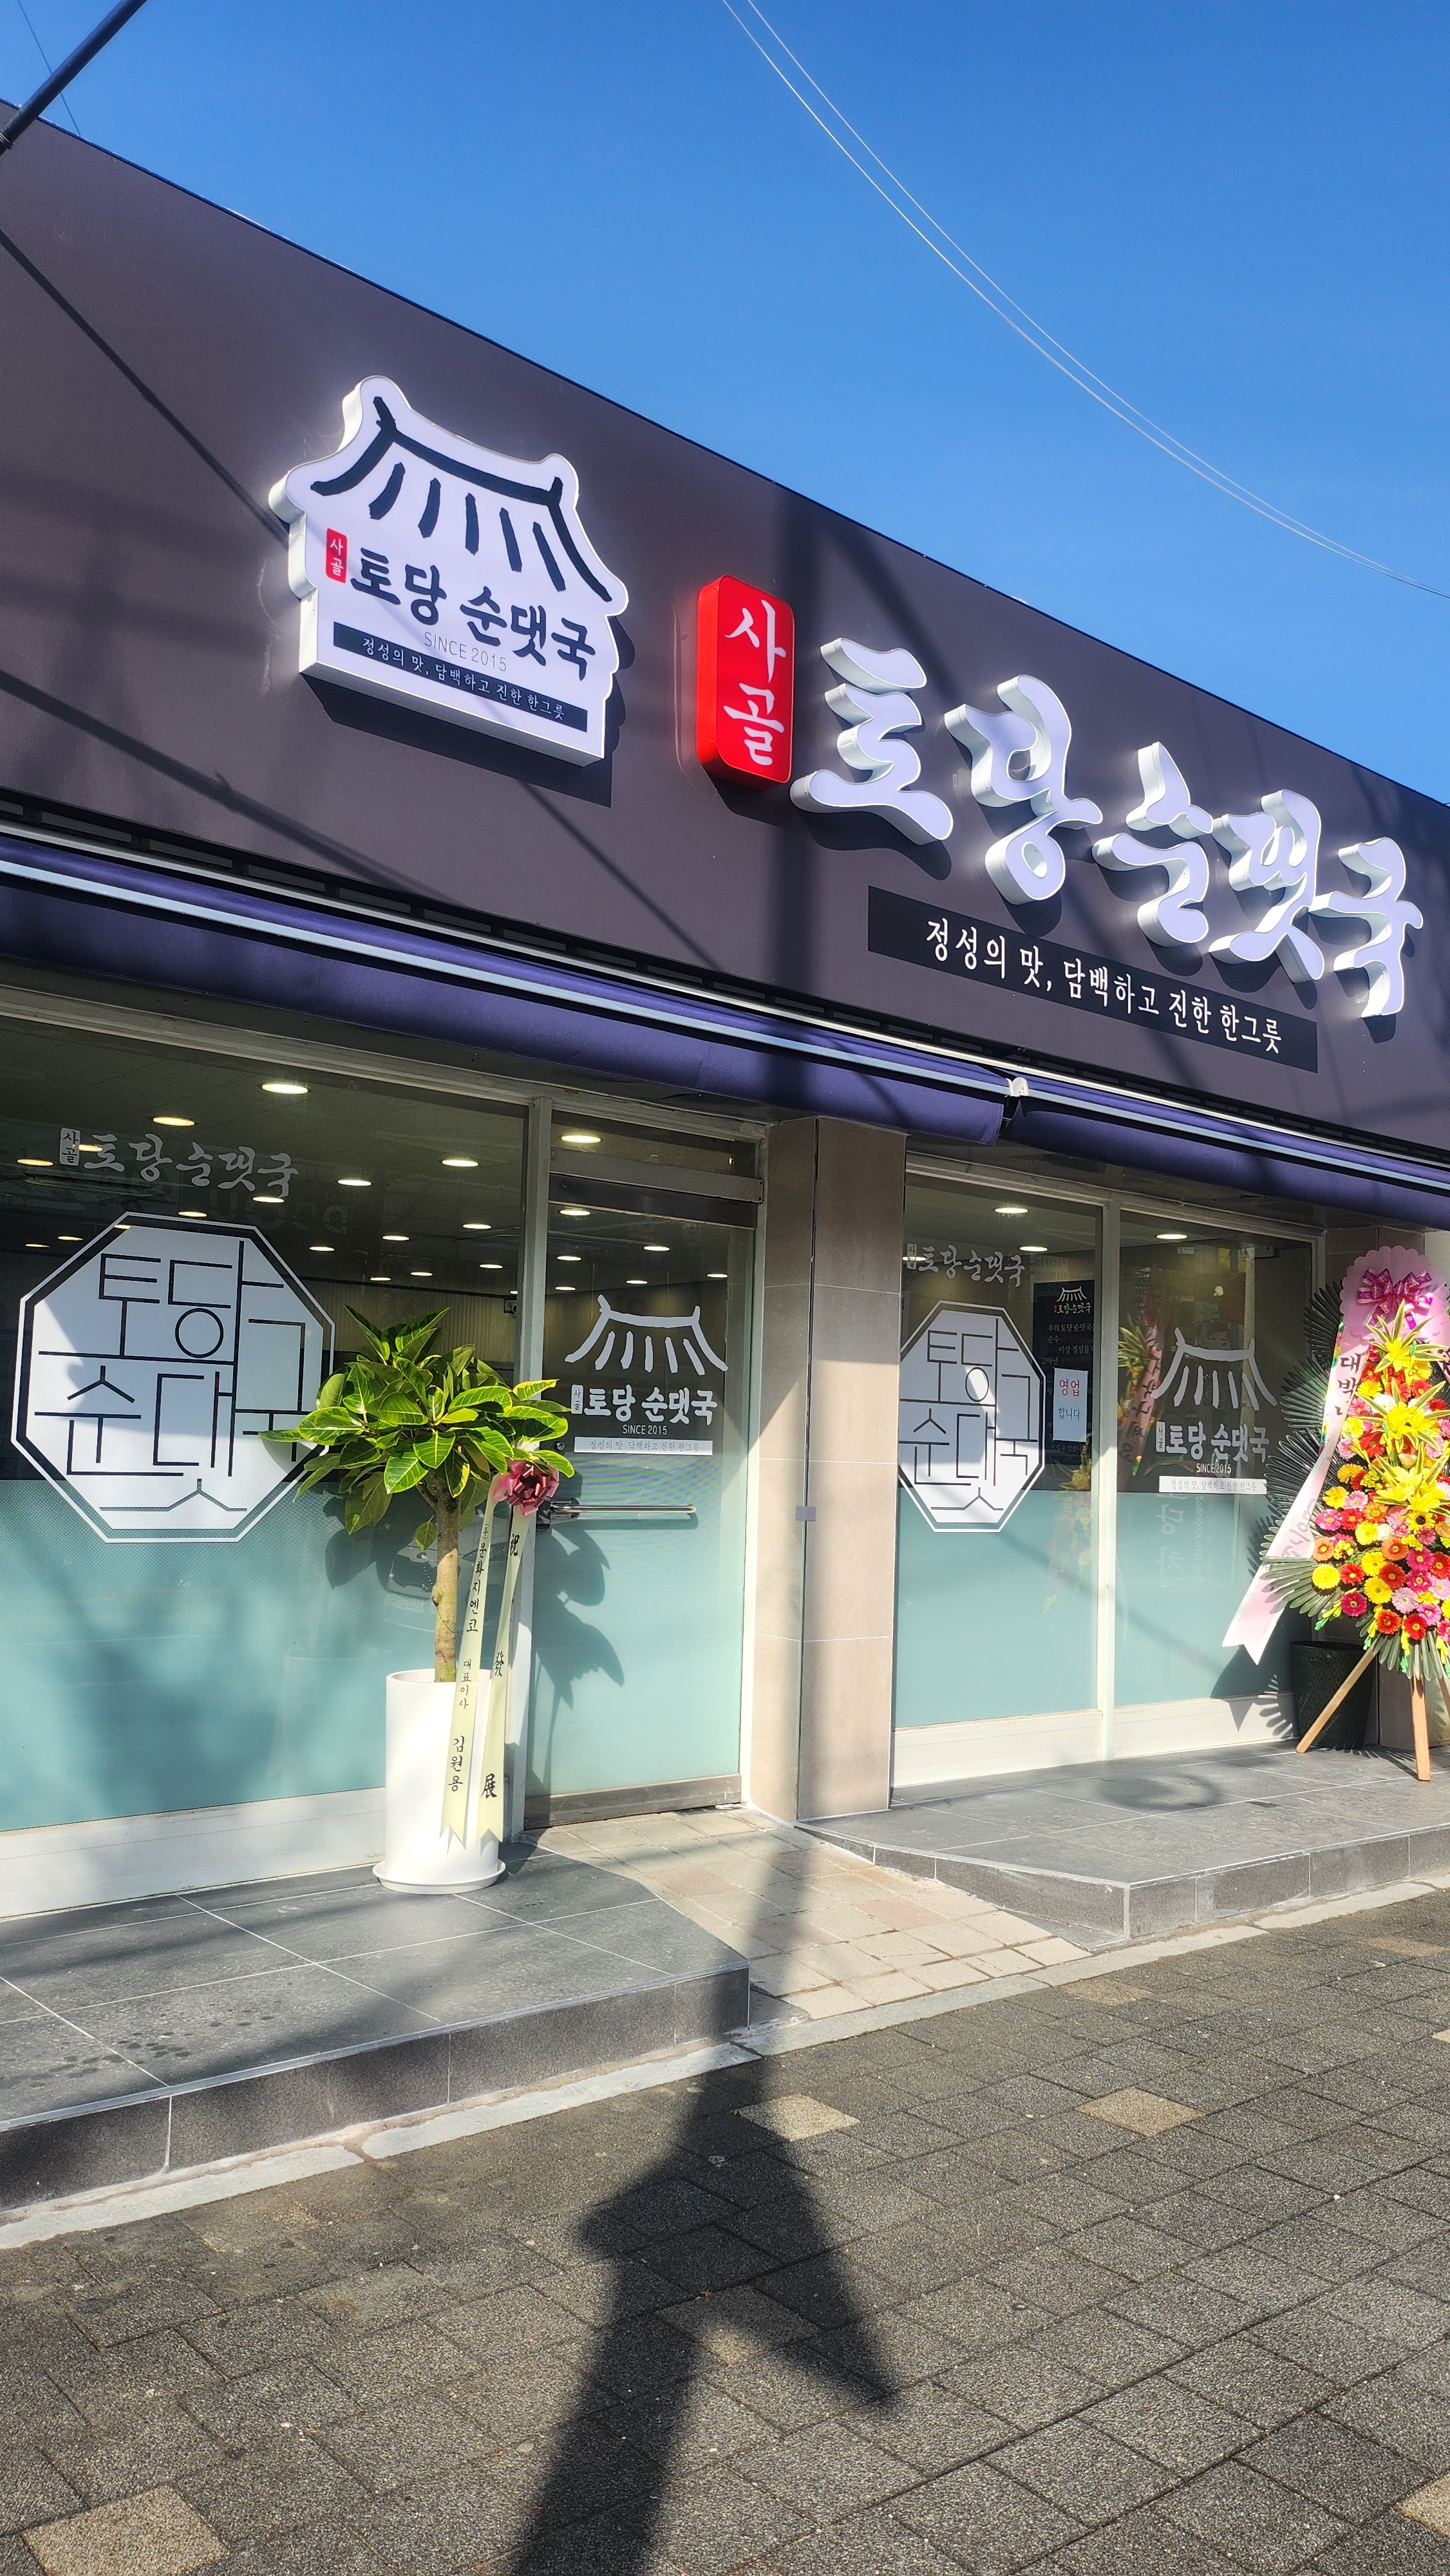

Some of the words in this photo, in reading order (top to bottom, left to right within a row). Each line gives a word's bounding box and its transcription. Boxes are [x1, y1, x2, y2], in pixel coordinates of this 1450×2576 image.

[330, 538, 344, 577] 사골
[350, 547, 447, 626] 토당
[459, 585, 597, 681] 순댓국
[424, 631, 467, 660] SINCE
[471, 647, 507, 672] 2015
[362, 637, 404, 667] 정성의
[411, 655, 429, 676] 맛,
[435, 664, 491, 694] 담백하고
[496, 684, 522, 706] 진한
[527, 694, 565, 721] 한그릇
[724, 599, 787, 767] 사골
[926, 917, 1006, 980] 정성의
[1019, 945, 1052, 992] 맛,
[1064, 958, 1160, 1015] 담백하고
[1169, 989, 1212, 1034] 진한
[1219, 1004, 1282, 1054] 한그릇
[1048, 1324, 1059, 1332] 우리
[573, 1388, 581, 1411] 사골
[1059, 1378, 1080, 1397] 영업
[584, 1384, 636, 1422] 토당
[641, 1387, 718, 1426] 순댓국
[1058, 1407, 1081, 1421] 합니다
[622, 1424, 646, 1435] SINCE
[647, 1425, 668, 1435] 2015
[1157, 1425, 1163, 1449] 사골
[1166, 1421, 1207, 1461] 토당
[1210, 1423, 1270, 1463] 순댓국
[590, 1440, 613, 1450] 정성의
[628, 1441, 659, 1452] 담백하고
[661, 1442, 676, 1452] 진한
[1196, 1463, 1215, 1473] SINCE
[1216, 1464, 1232, 1474] 2015
[1171, 1479, 1189, 1490] 정성의
[509, 1533, 520, 1557] 祝
[458, 1658, 472, 1710] 대표이사
[447, 1735, 464, 1792] 김원용
[481, 1773, 498, 1799] 展
